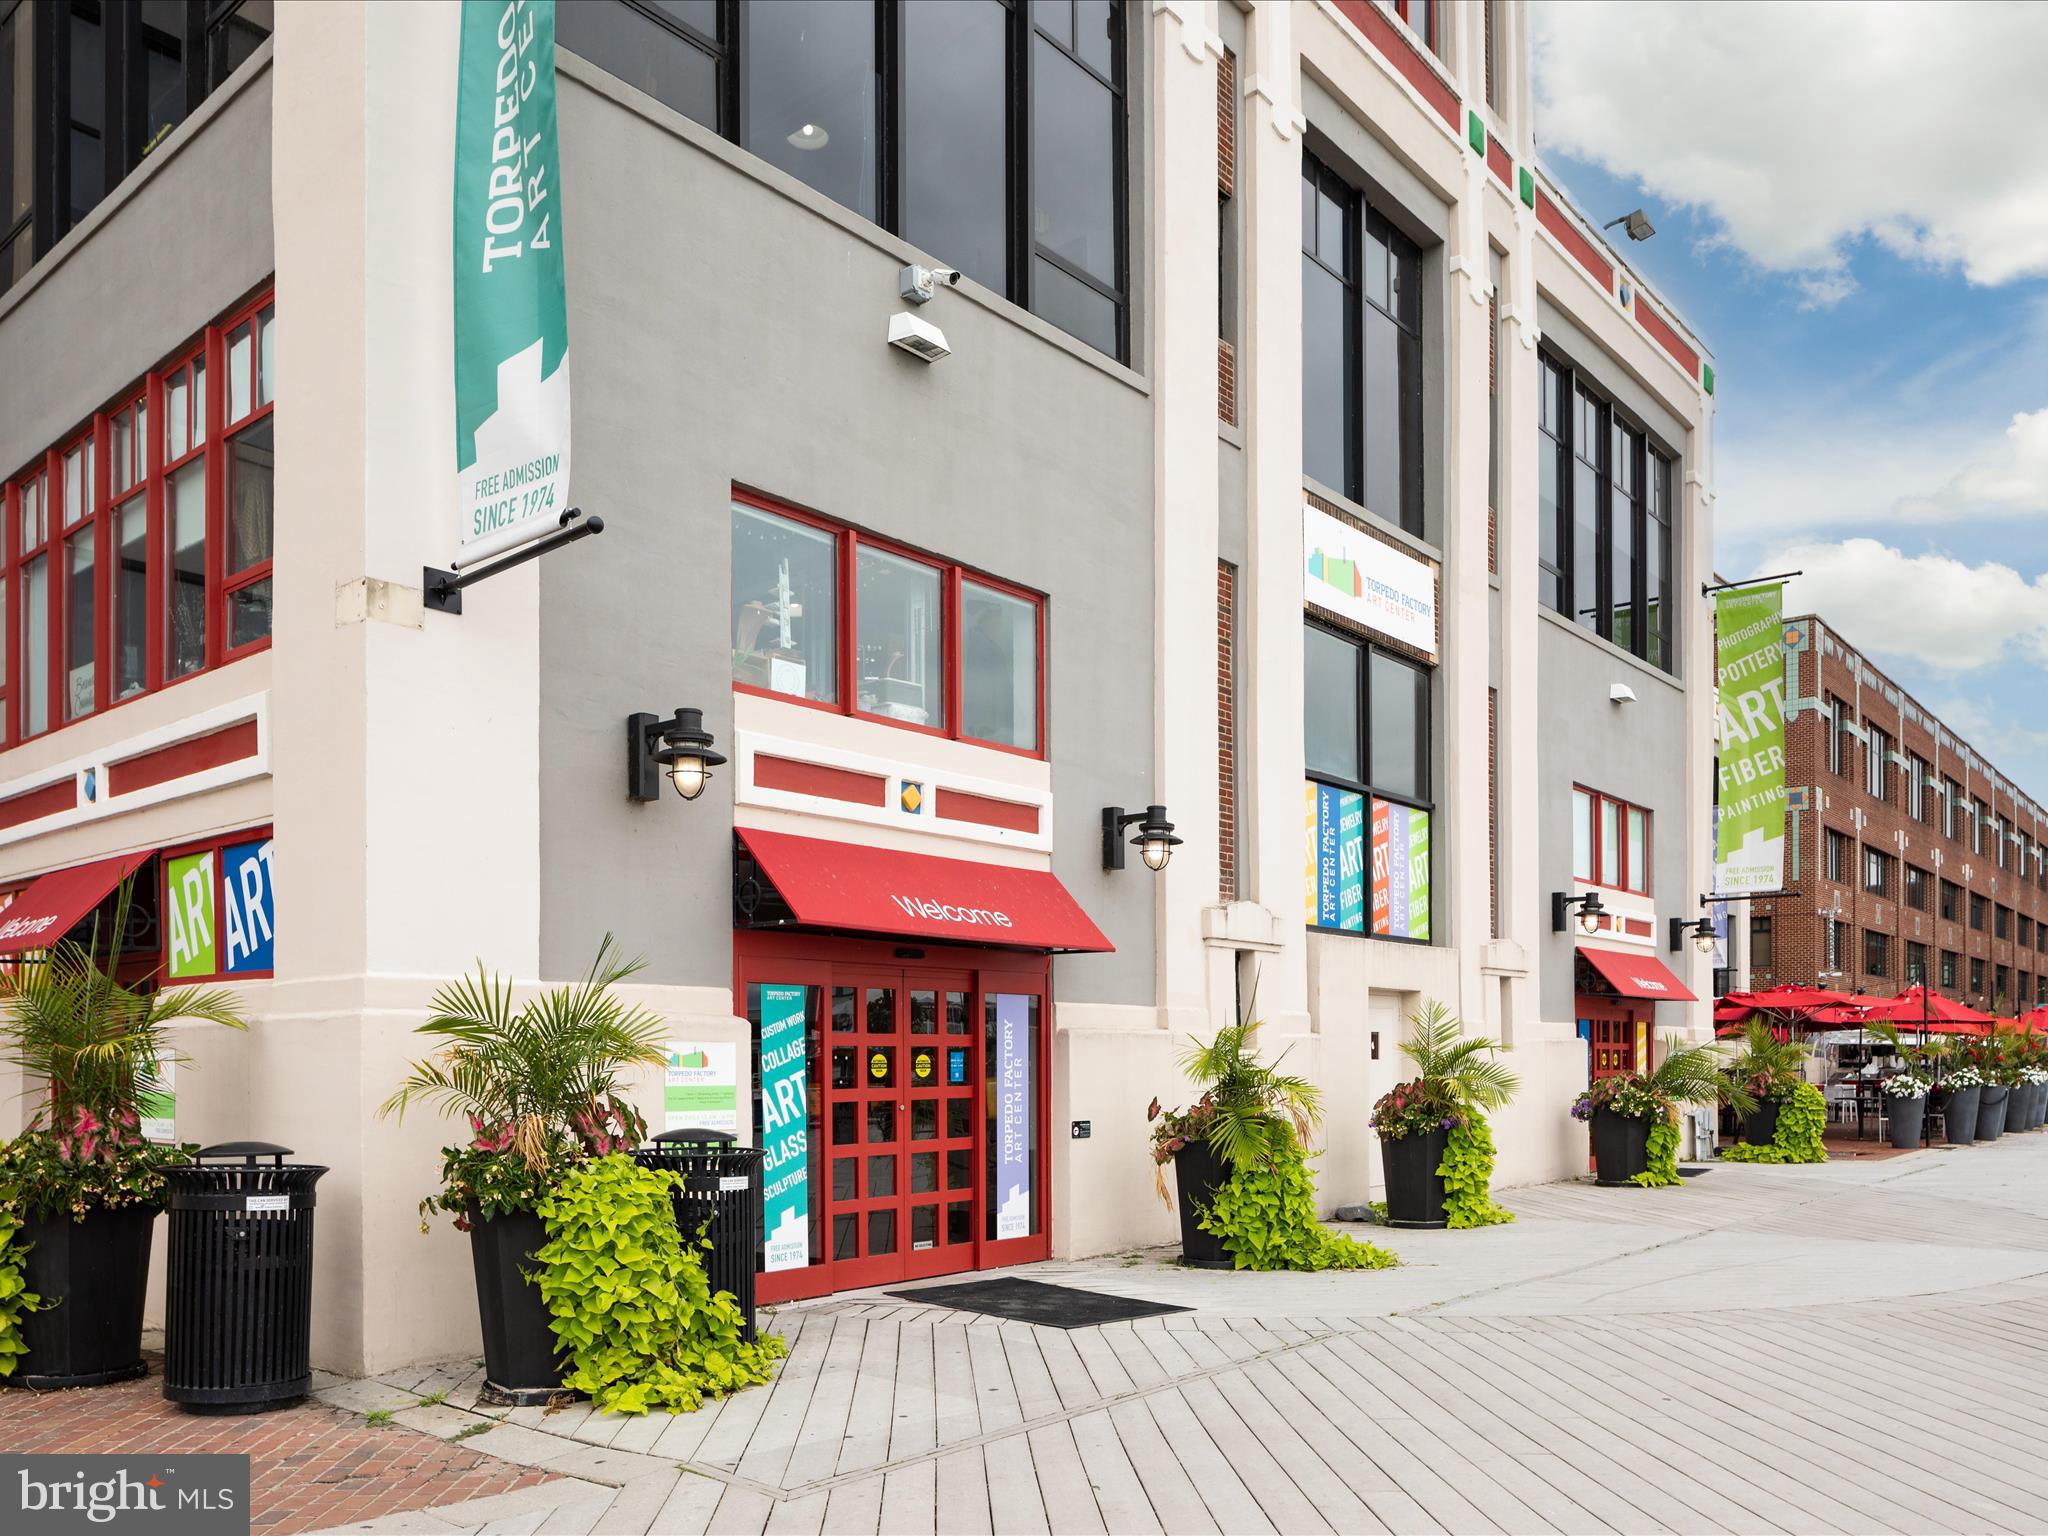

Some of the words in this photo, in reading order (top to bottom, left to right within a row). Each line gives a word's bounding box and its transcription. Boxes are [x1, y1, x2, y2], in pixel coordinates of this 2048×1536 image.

[483, 1, 525, 273] TORPEDO
[523, 132, 550, 249] ART
[475, 474, 500, 500] FREE
[502, 453, 560, 491] ADMISSION
[473, 497, 517, 536] SINCE
[522, 482, 555, 518] 1974
[1366, 576, 1400, 602] TORPEDO
[1401, 593, 1432, 617] FACTORY
[1718, 611, 1782, 651] PHOTOGRAPHY
[1718, 642, 1783, 687] POTTERY
[1719, 676, 1784, 752] ART
[1719, 745, 1785, 792] FIBER
[1322, 791, 1330, 853] FACTORY
[1718, 784, 1785, 822] PAINTING
[1340, 836, 1363, 880] ART
[1409, 851, 1428, 893] ART
[1724, 876, 1750, 887] SINCE
[1753, 873, 1775, 885] 1974
[224, 839, 274, 971] ART
[890, 894, 1013, 928] Welcome
[1322, 857, 1330, 921] TORPEDO
[1340, 883, 1363, 911] FIBER
[1409, 895, 1428, 920] FIBER
[169, 850, 214, 977] ART
[761, 1018, 787, 1039] CUSTOM
[786, 1010, 806, 1028] WORK
[761, 1036, 806, 1073] COLLAGE
[1004, 1019, 1013, 1087] FACTORY
[761, 1069, 807, 1134] ART
[1014, 1057, 1022, 1124] CENTER
[763, 1129, 807, 1172] GLASS
[1004, 1093, 1013, 1164] TORPEDO
[1014, 1132, 1022, 1163] ART
[763, 1166, 808, 1201] SCULPTURE
[770, 1253, 788, 1264] SINCE
[789, 1250, 803, 1261] 1974
